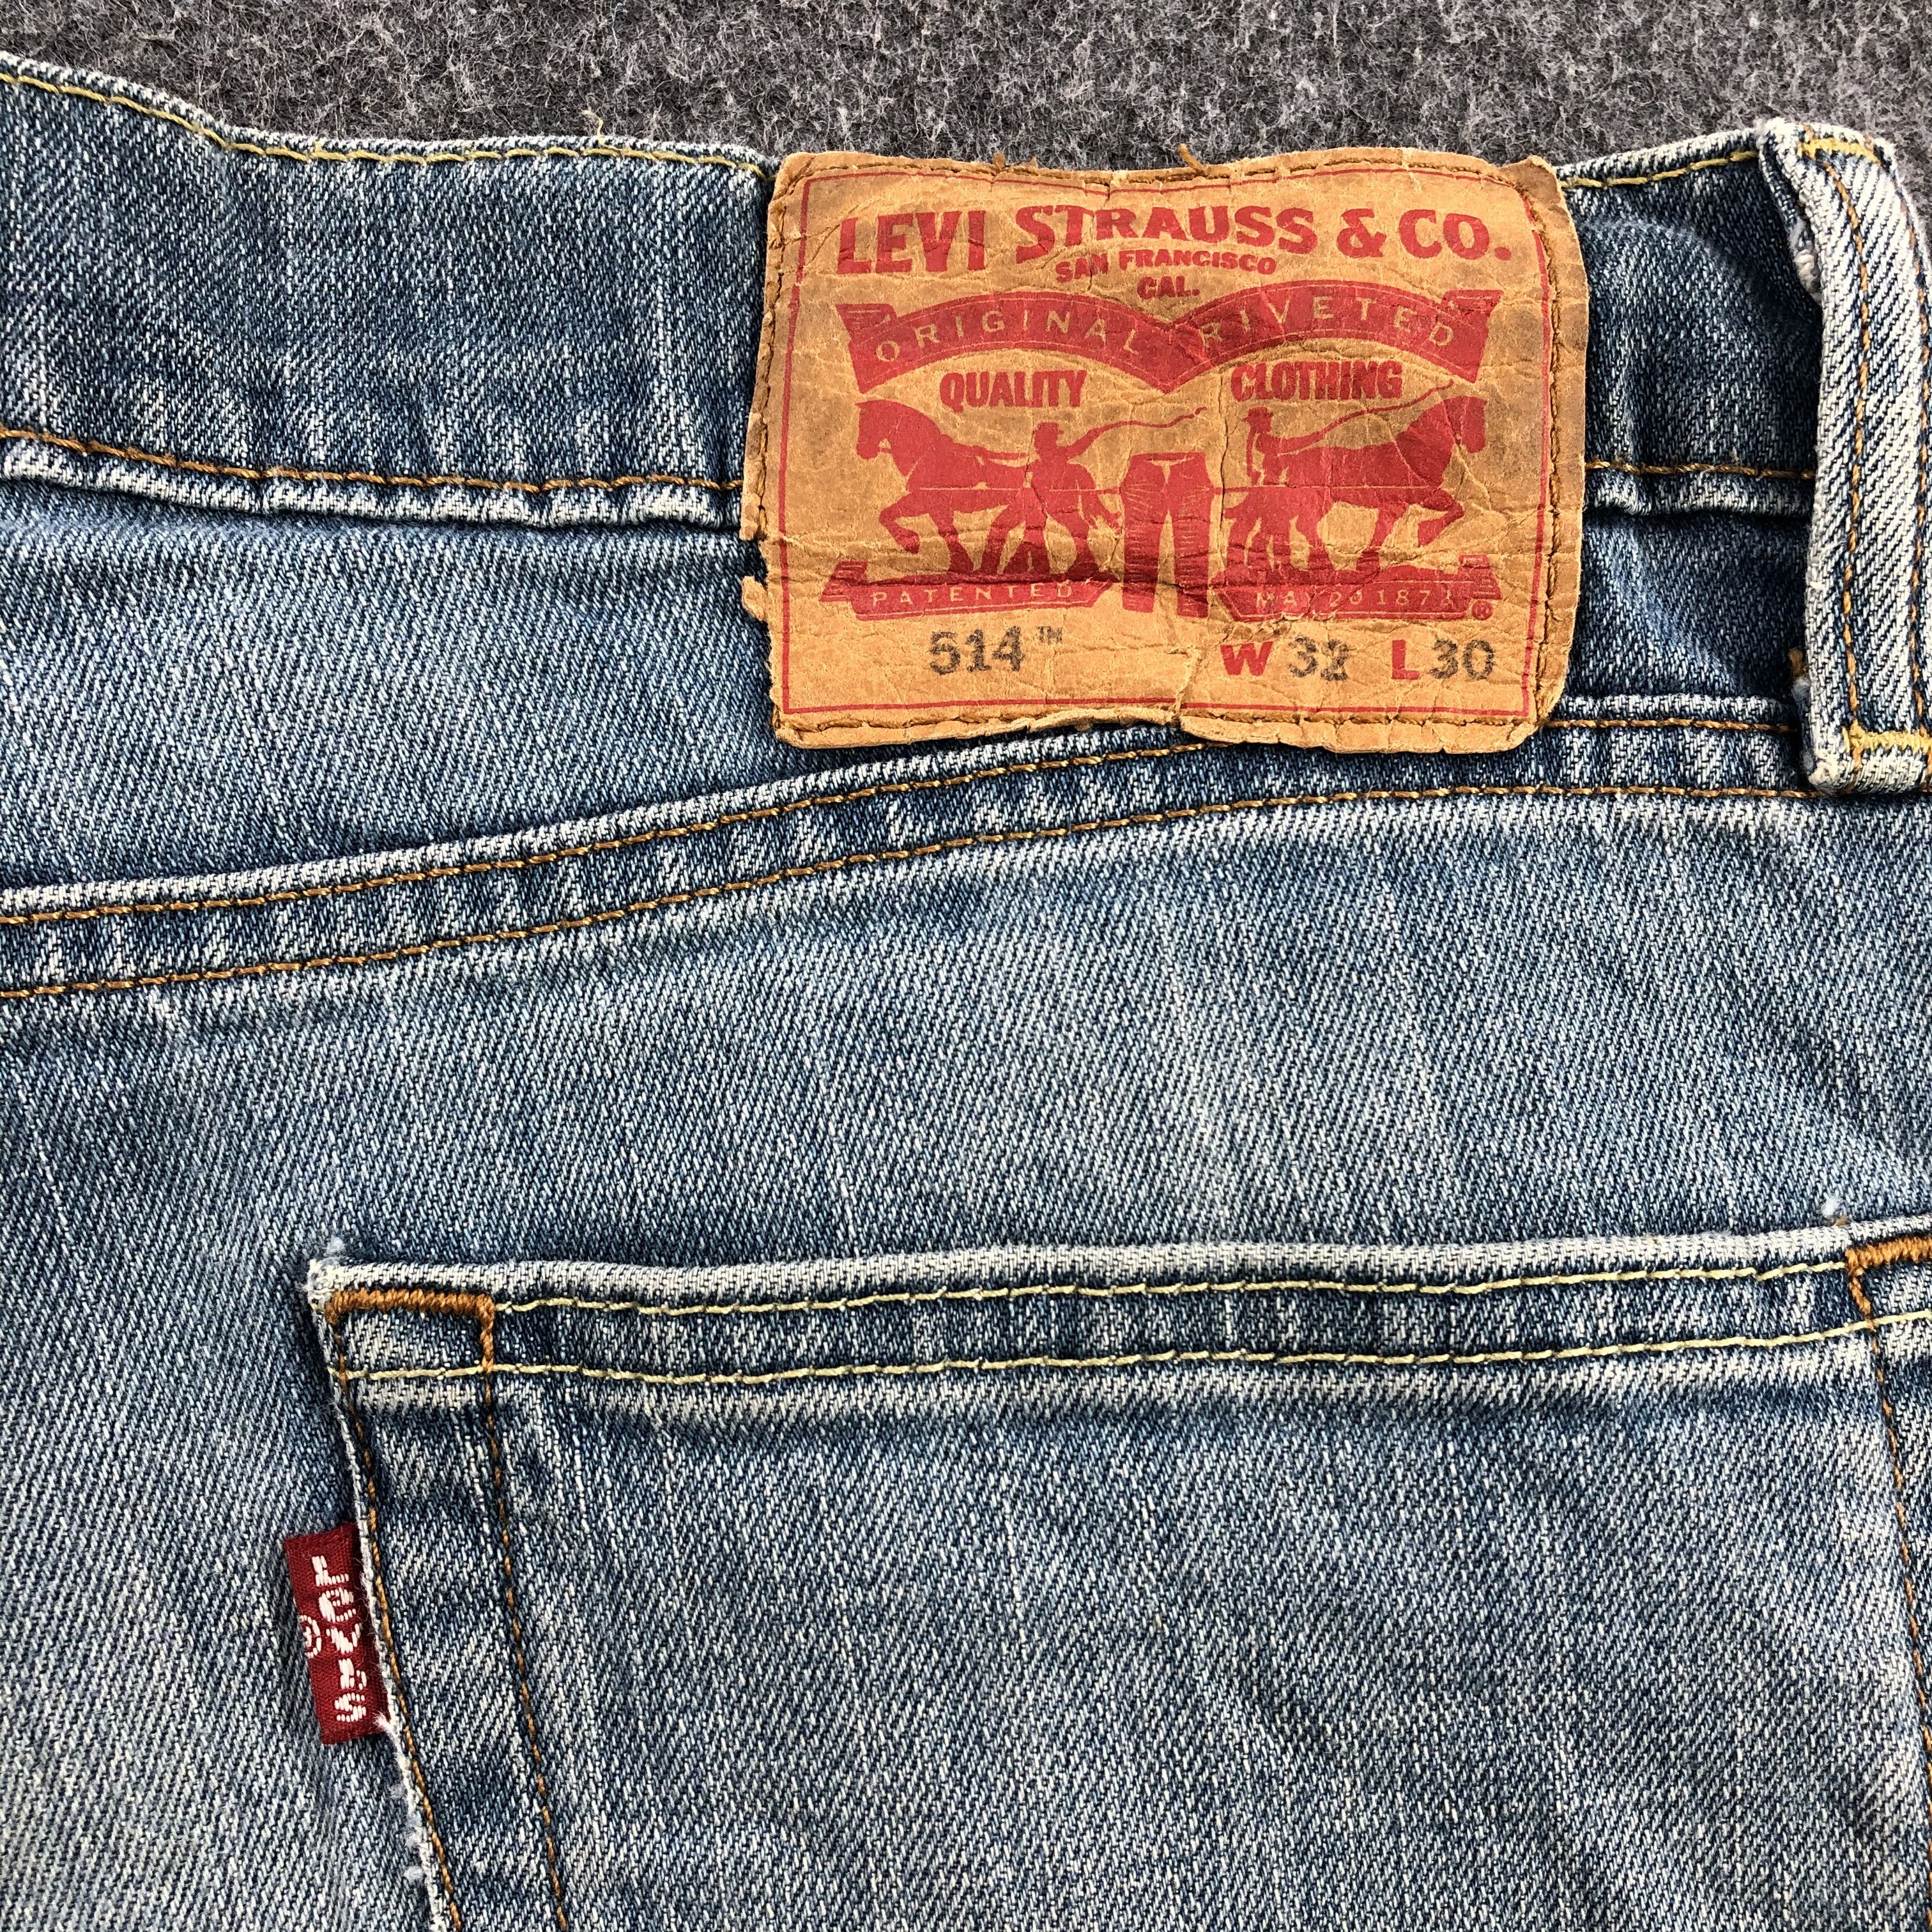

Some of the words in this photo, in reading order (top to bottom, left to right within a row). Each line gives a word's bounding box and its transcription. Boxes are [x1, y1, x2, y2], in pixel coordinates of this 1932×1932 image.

[836, 210, 986, 275] LEVI
[1016, 204, 1317, 264] STRAUSS
[1337, 208, 1387, 259] &
[1399, 209, 1512, 261] CO.
[1055, 250, 1109, 283] SAN
[1118, 249, 1278, 275] FRANCISCO
[1136, 275, 1200, 300] CAL.
[875, 309, 1141, 363] ORIGINAL
[1198, 294, 1455, 349] RIVETED
[939, 369, 1089, 413] QUALITY
[1230, 360, 1403, 402] CLOTHING
[871, 581, 1073, 608] PATENTED
